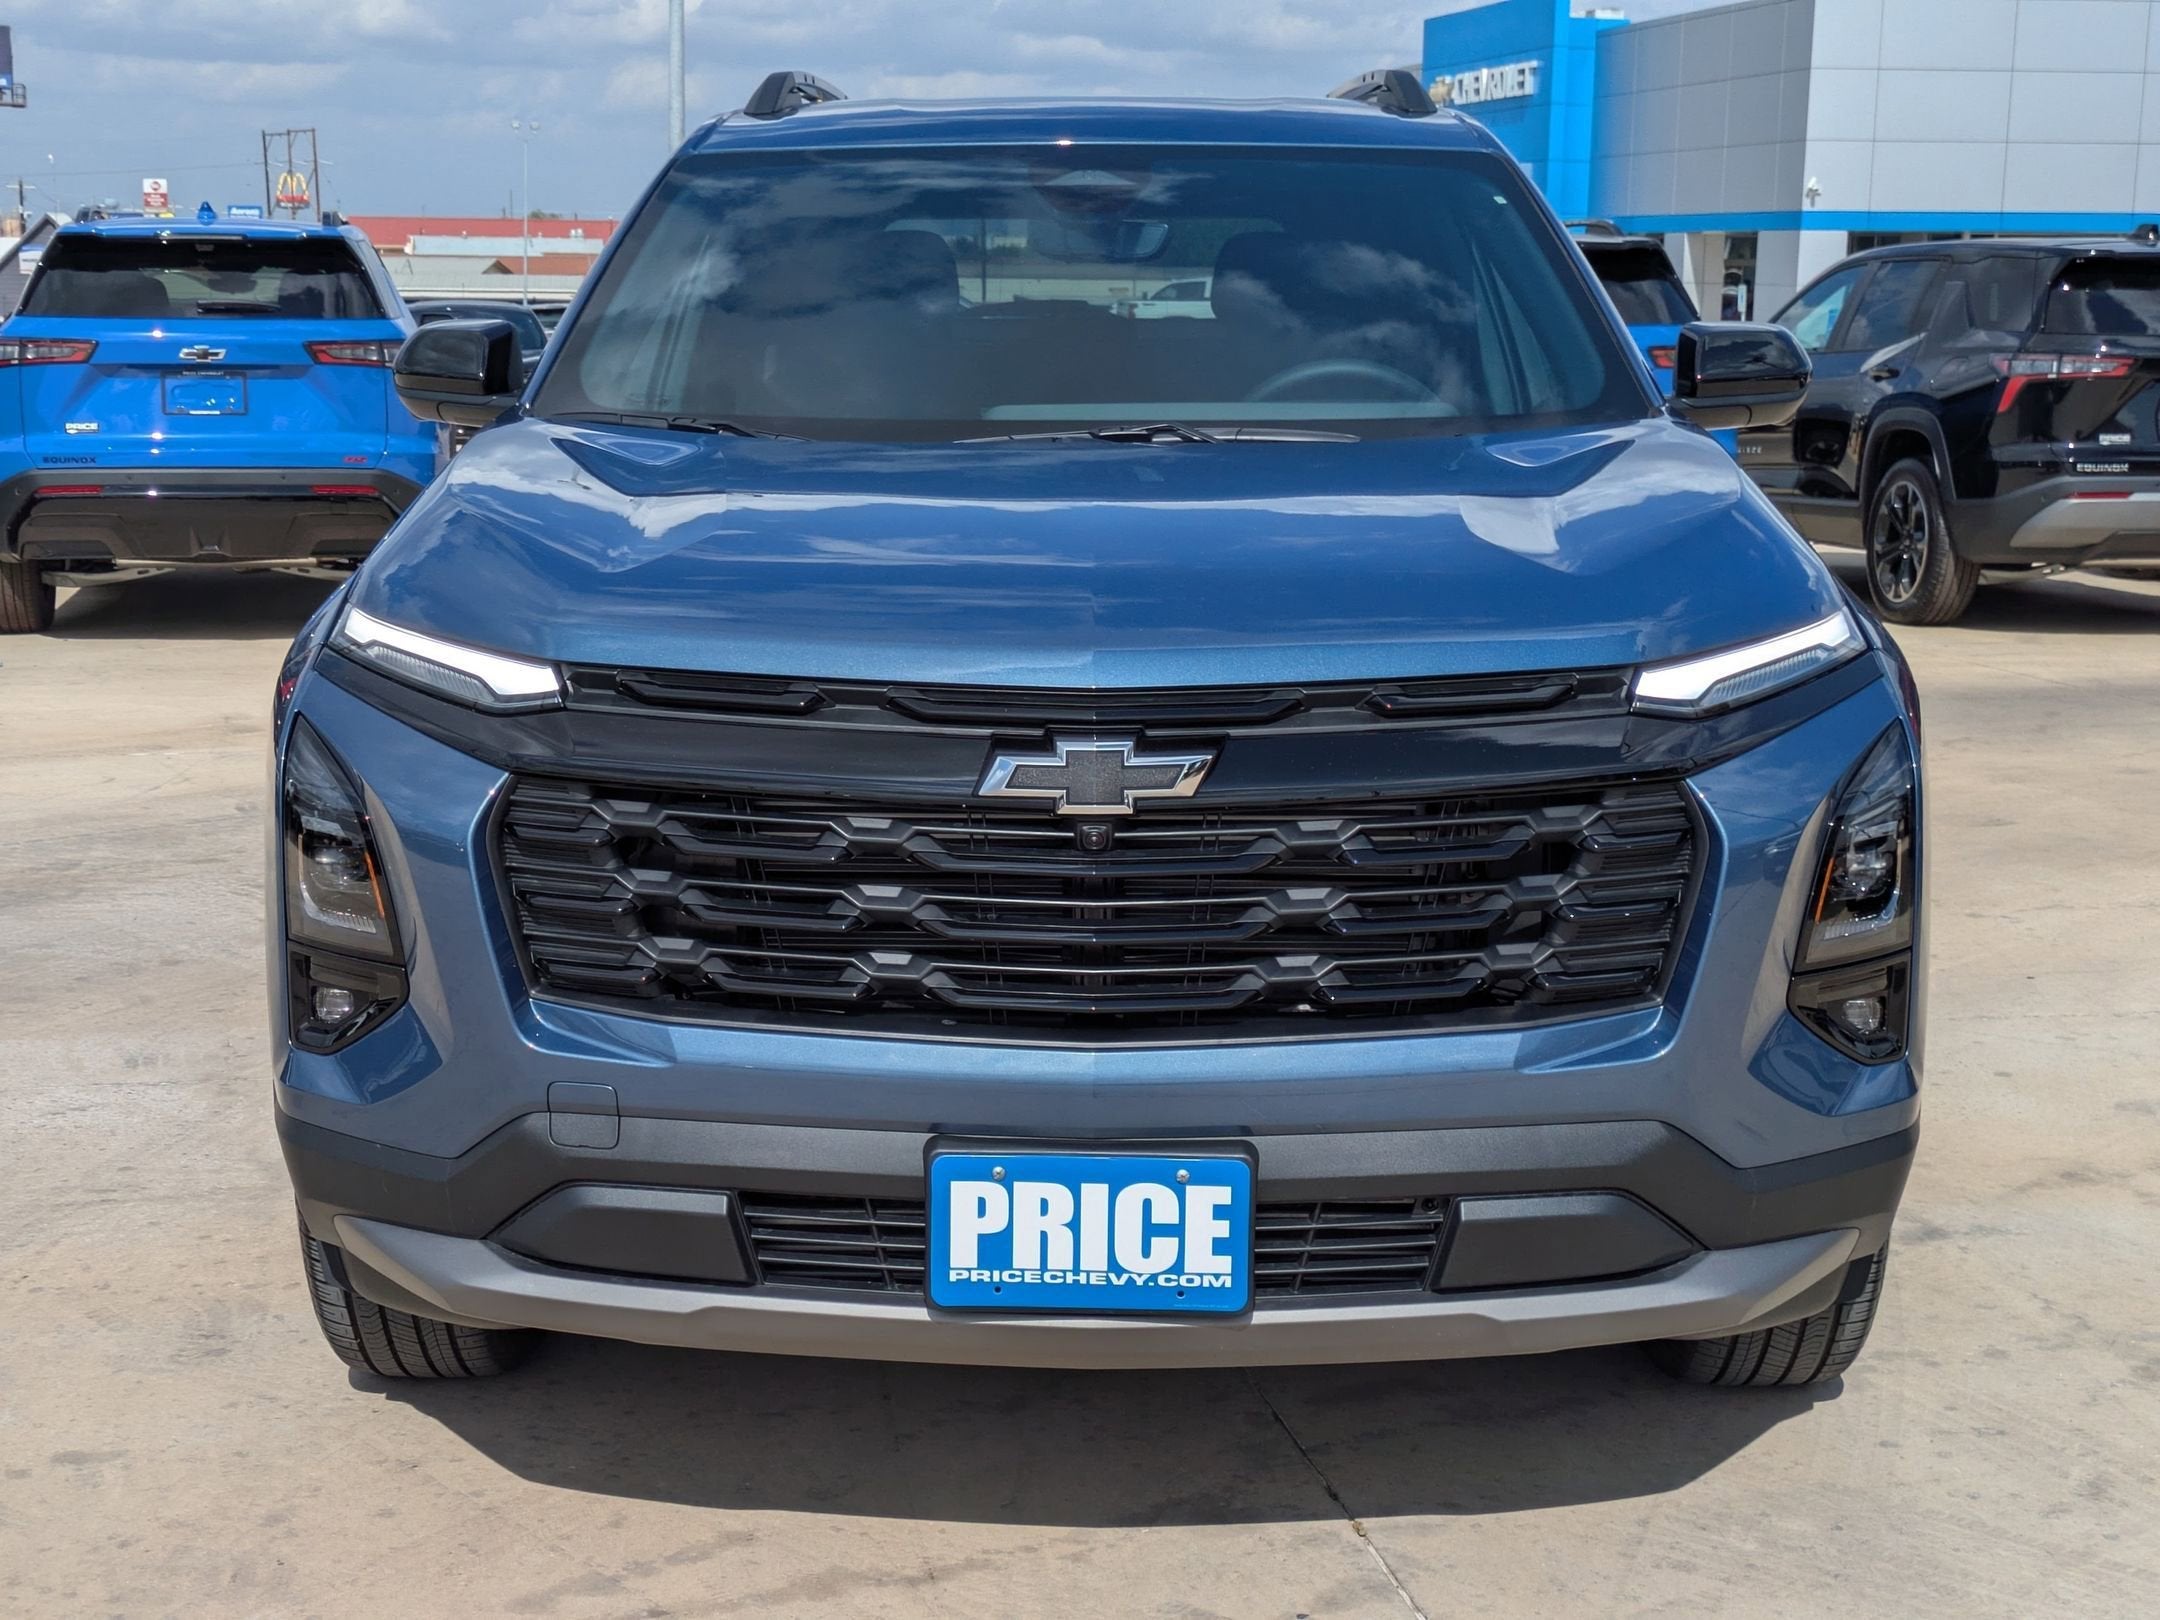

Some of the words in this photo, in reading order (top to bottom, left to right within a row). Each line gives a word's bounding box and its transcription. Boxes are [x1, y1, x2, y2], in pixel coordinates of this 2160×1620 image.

[1453, 60, 1538, 105] CHEVROLET
[43, 456, 96, 464] EQUINOX
[2077, 463, 2129, 472] EQUINOX
[949, 1181, 1232, 1274] PRICE
[949, 1268, 1232, 1288] PRICECHEVY.COM
